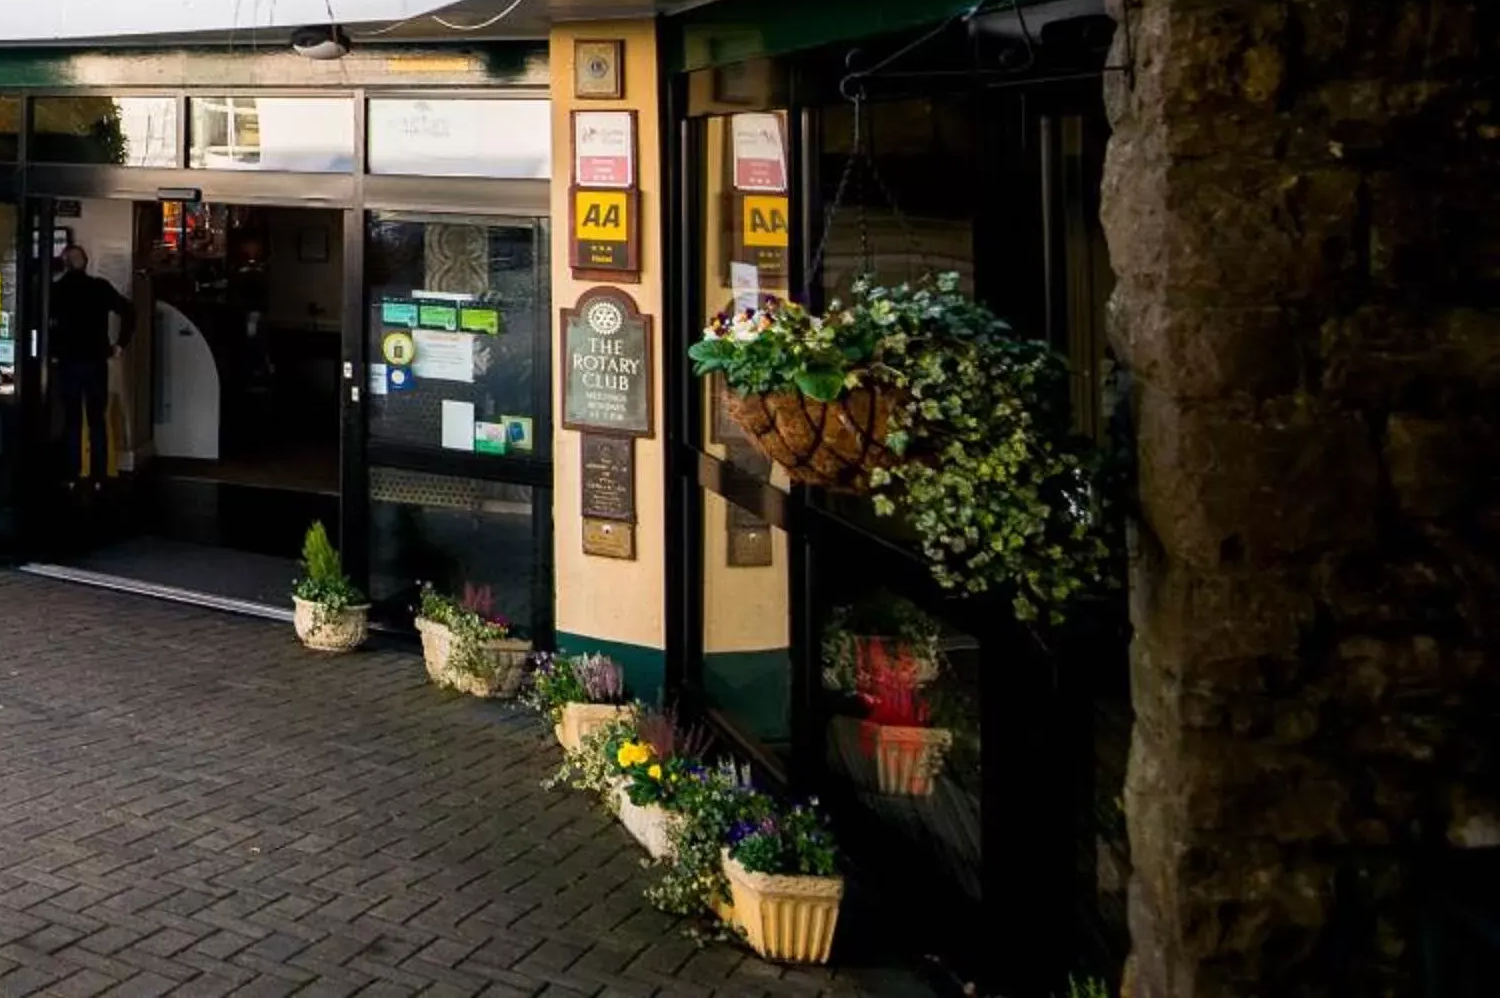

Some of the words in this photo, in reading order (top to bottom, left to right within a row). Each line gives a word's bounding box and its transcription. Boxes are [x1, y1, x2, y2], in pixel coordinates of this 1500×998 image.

[582, 203, 621, 228] AA
[588, 337, 624, 355] THE
[573, 353, 641, 375] ROTARY
[581, 372, 629, 391] CLUB
